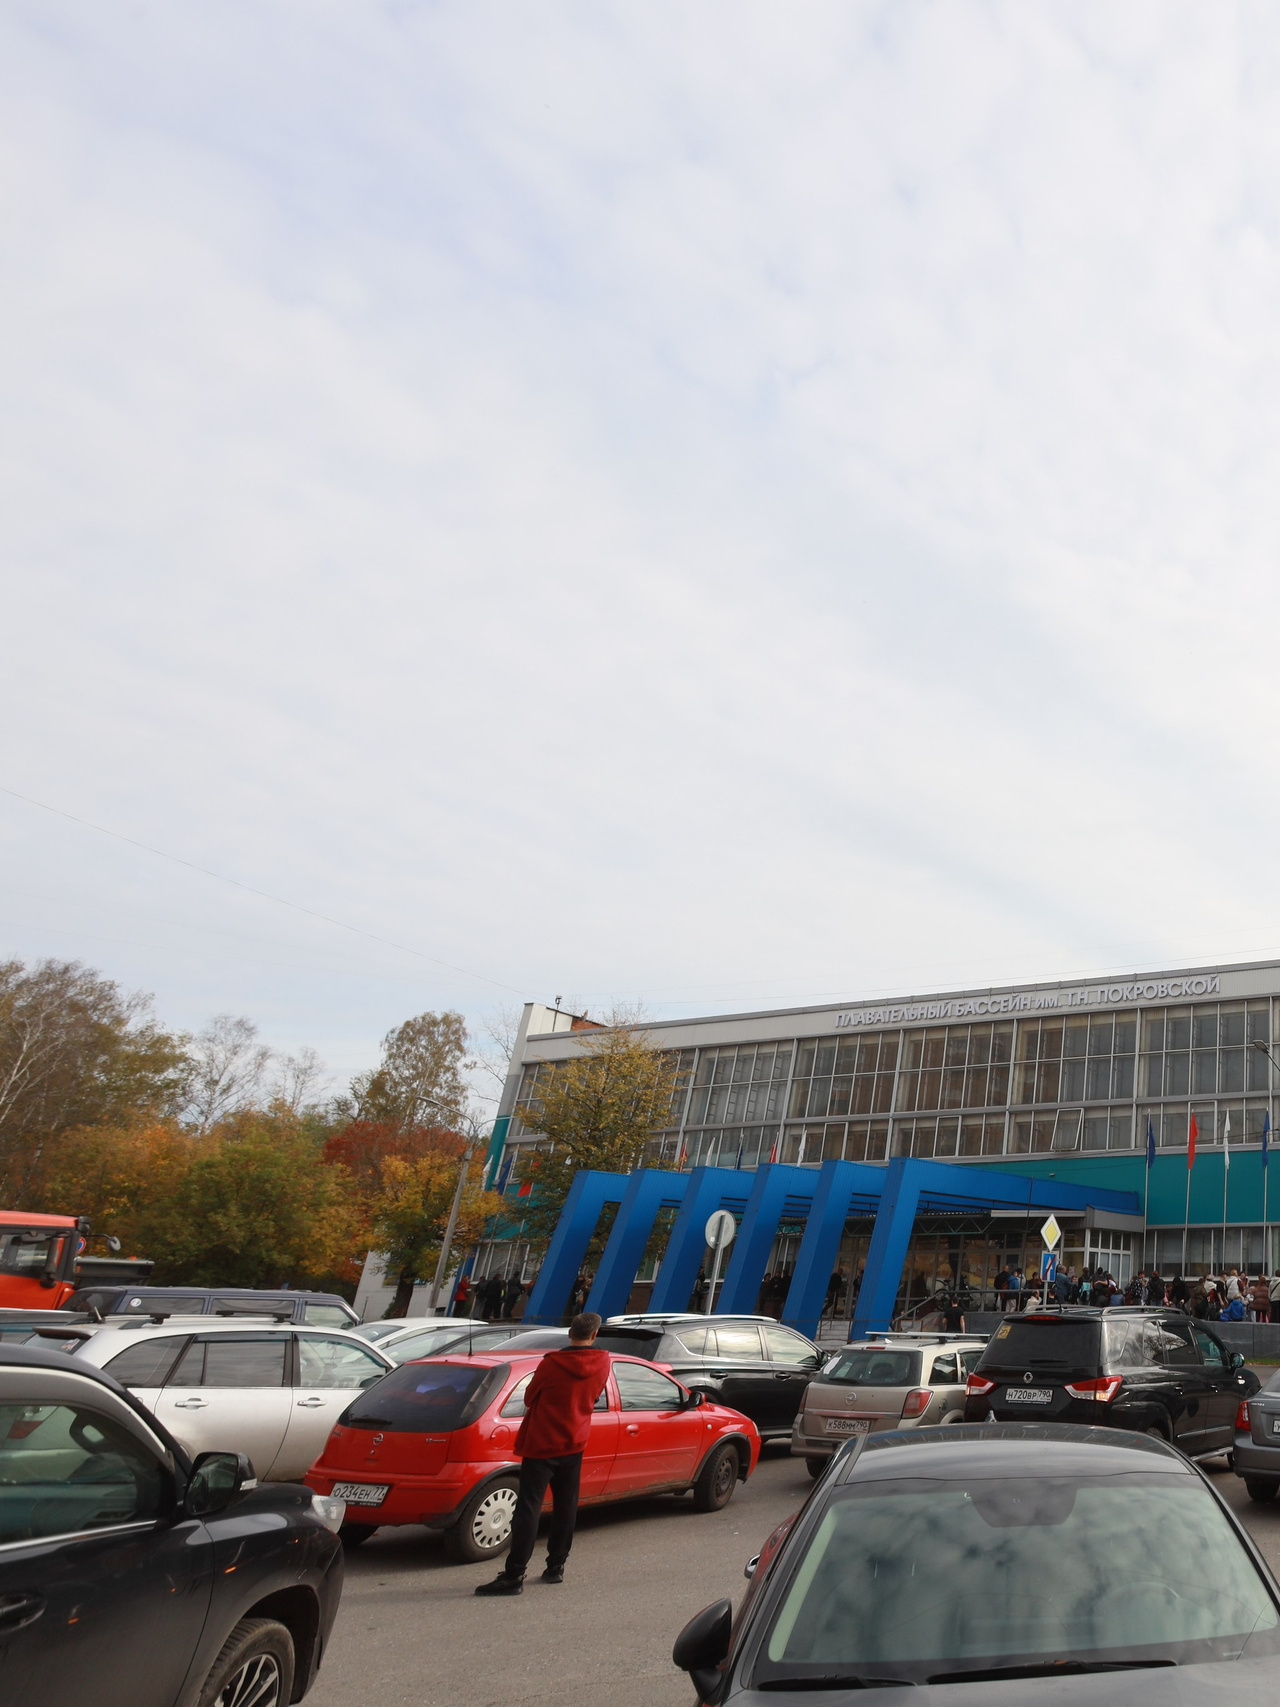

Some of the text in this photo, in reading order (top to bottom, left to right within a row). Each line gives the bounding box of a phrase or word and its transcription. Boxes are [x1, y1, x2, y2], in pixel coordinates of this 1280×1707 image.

[834, 1000, 951, 1028] ПЛАВАТЕЛЬНЫЙ
[954, 993, 1032, 1017] БАССЕЙН
[1097, 974, 1221, 1004] ПОКРОВСКОЙ
